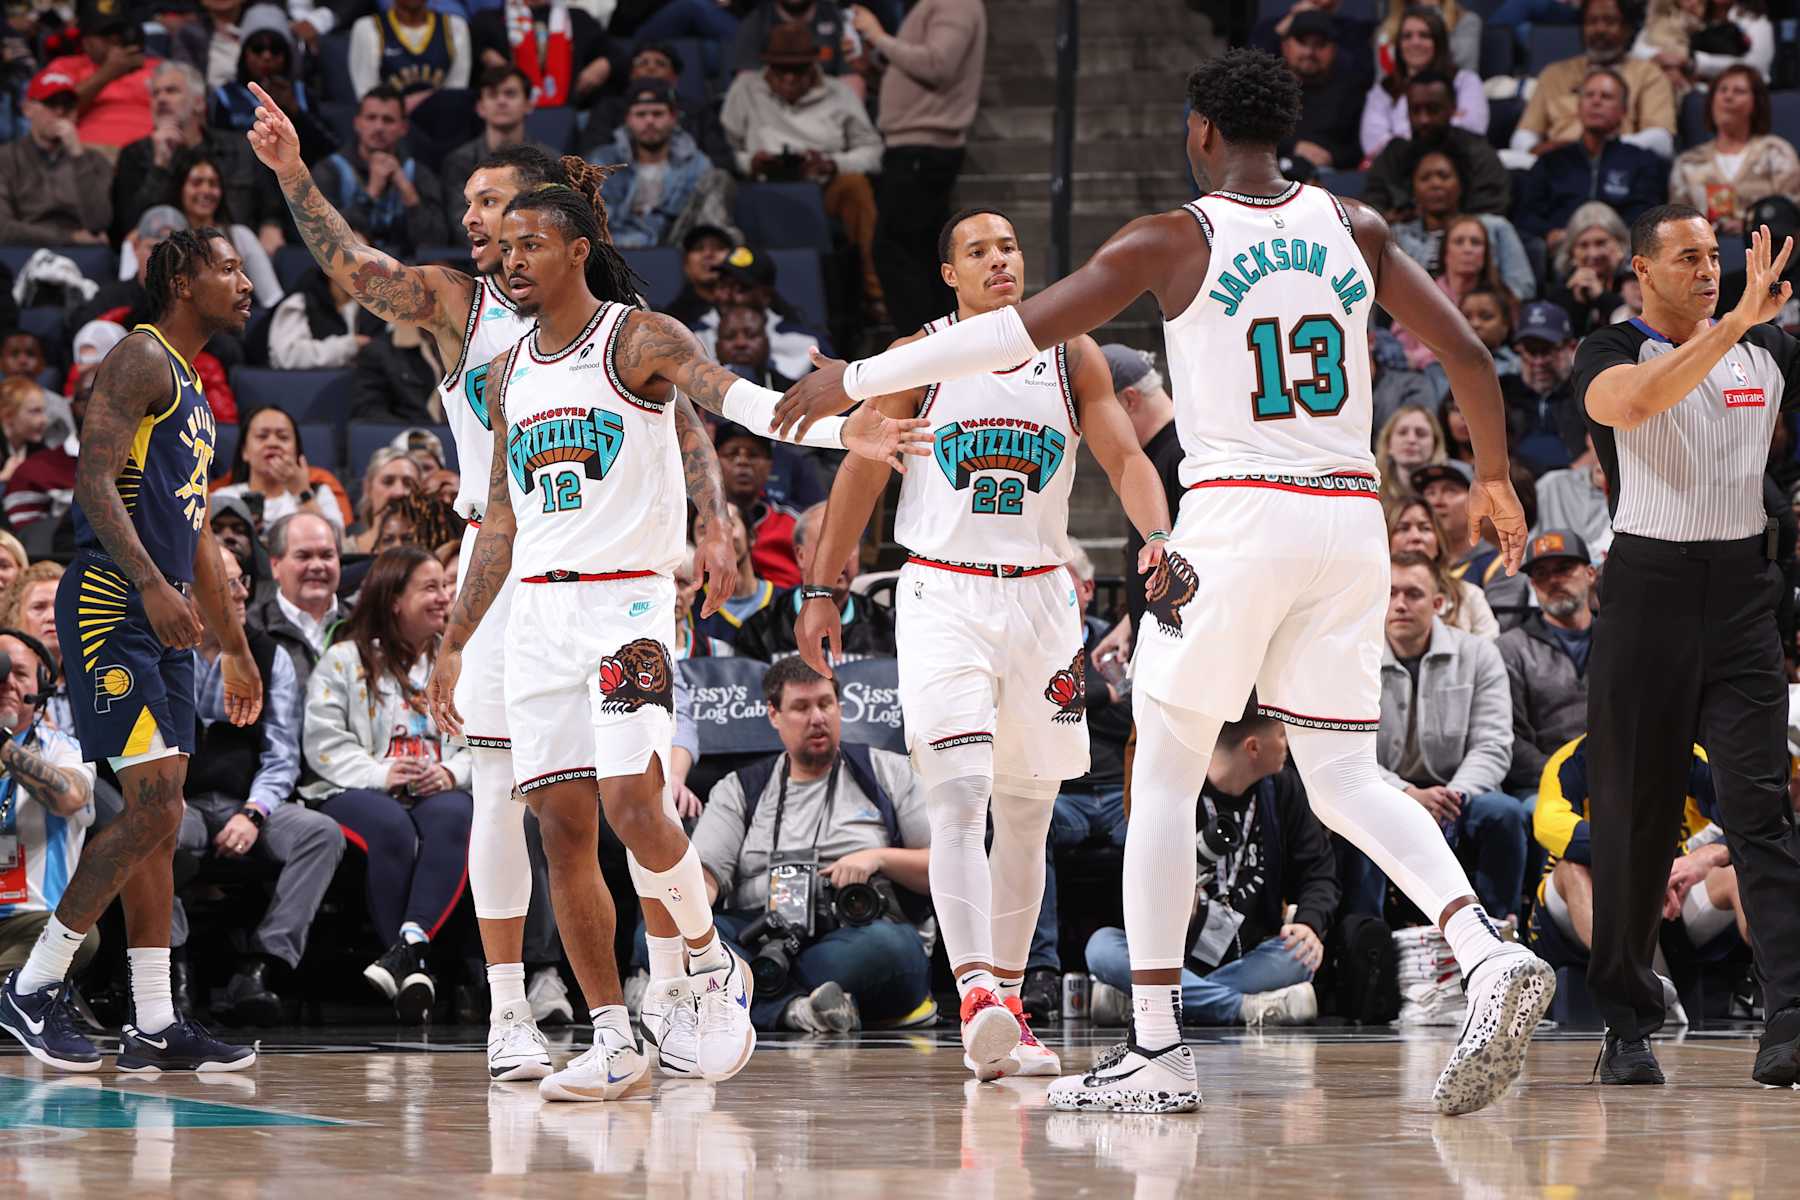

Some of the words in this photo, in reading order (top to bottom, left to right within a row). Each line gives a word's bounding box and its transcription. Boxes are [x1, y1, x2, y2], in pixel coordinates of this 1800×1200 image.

[1209, 238, 1327, 317] JACKSON
[1331, 267, 1368, 316] JR.
[1247, 313, 1349, 422] 13
[520, 407, 587, 428] VANCOUVER
[1725, 393, 1764, 404] Emirates
[961, 418, 1039, 432] VANCOUVER
[507, 407, 625, 495] GRIZZLIES
[933, 421, 1066, 494] GRIZZLIES
[539, 470, 582, 513] 12
[972, 476, 1024, 515] 22
[690, 684, 748, 708] issy's
[693, 703, 728, 724] Log
[730, 701, 768, 718] Cab
[840, 682, 902, 722] Siss
[867, 705, 902, 728] Log
